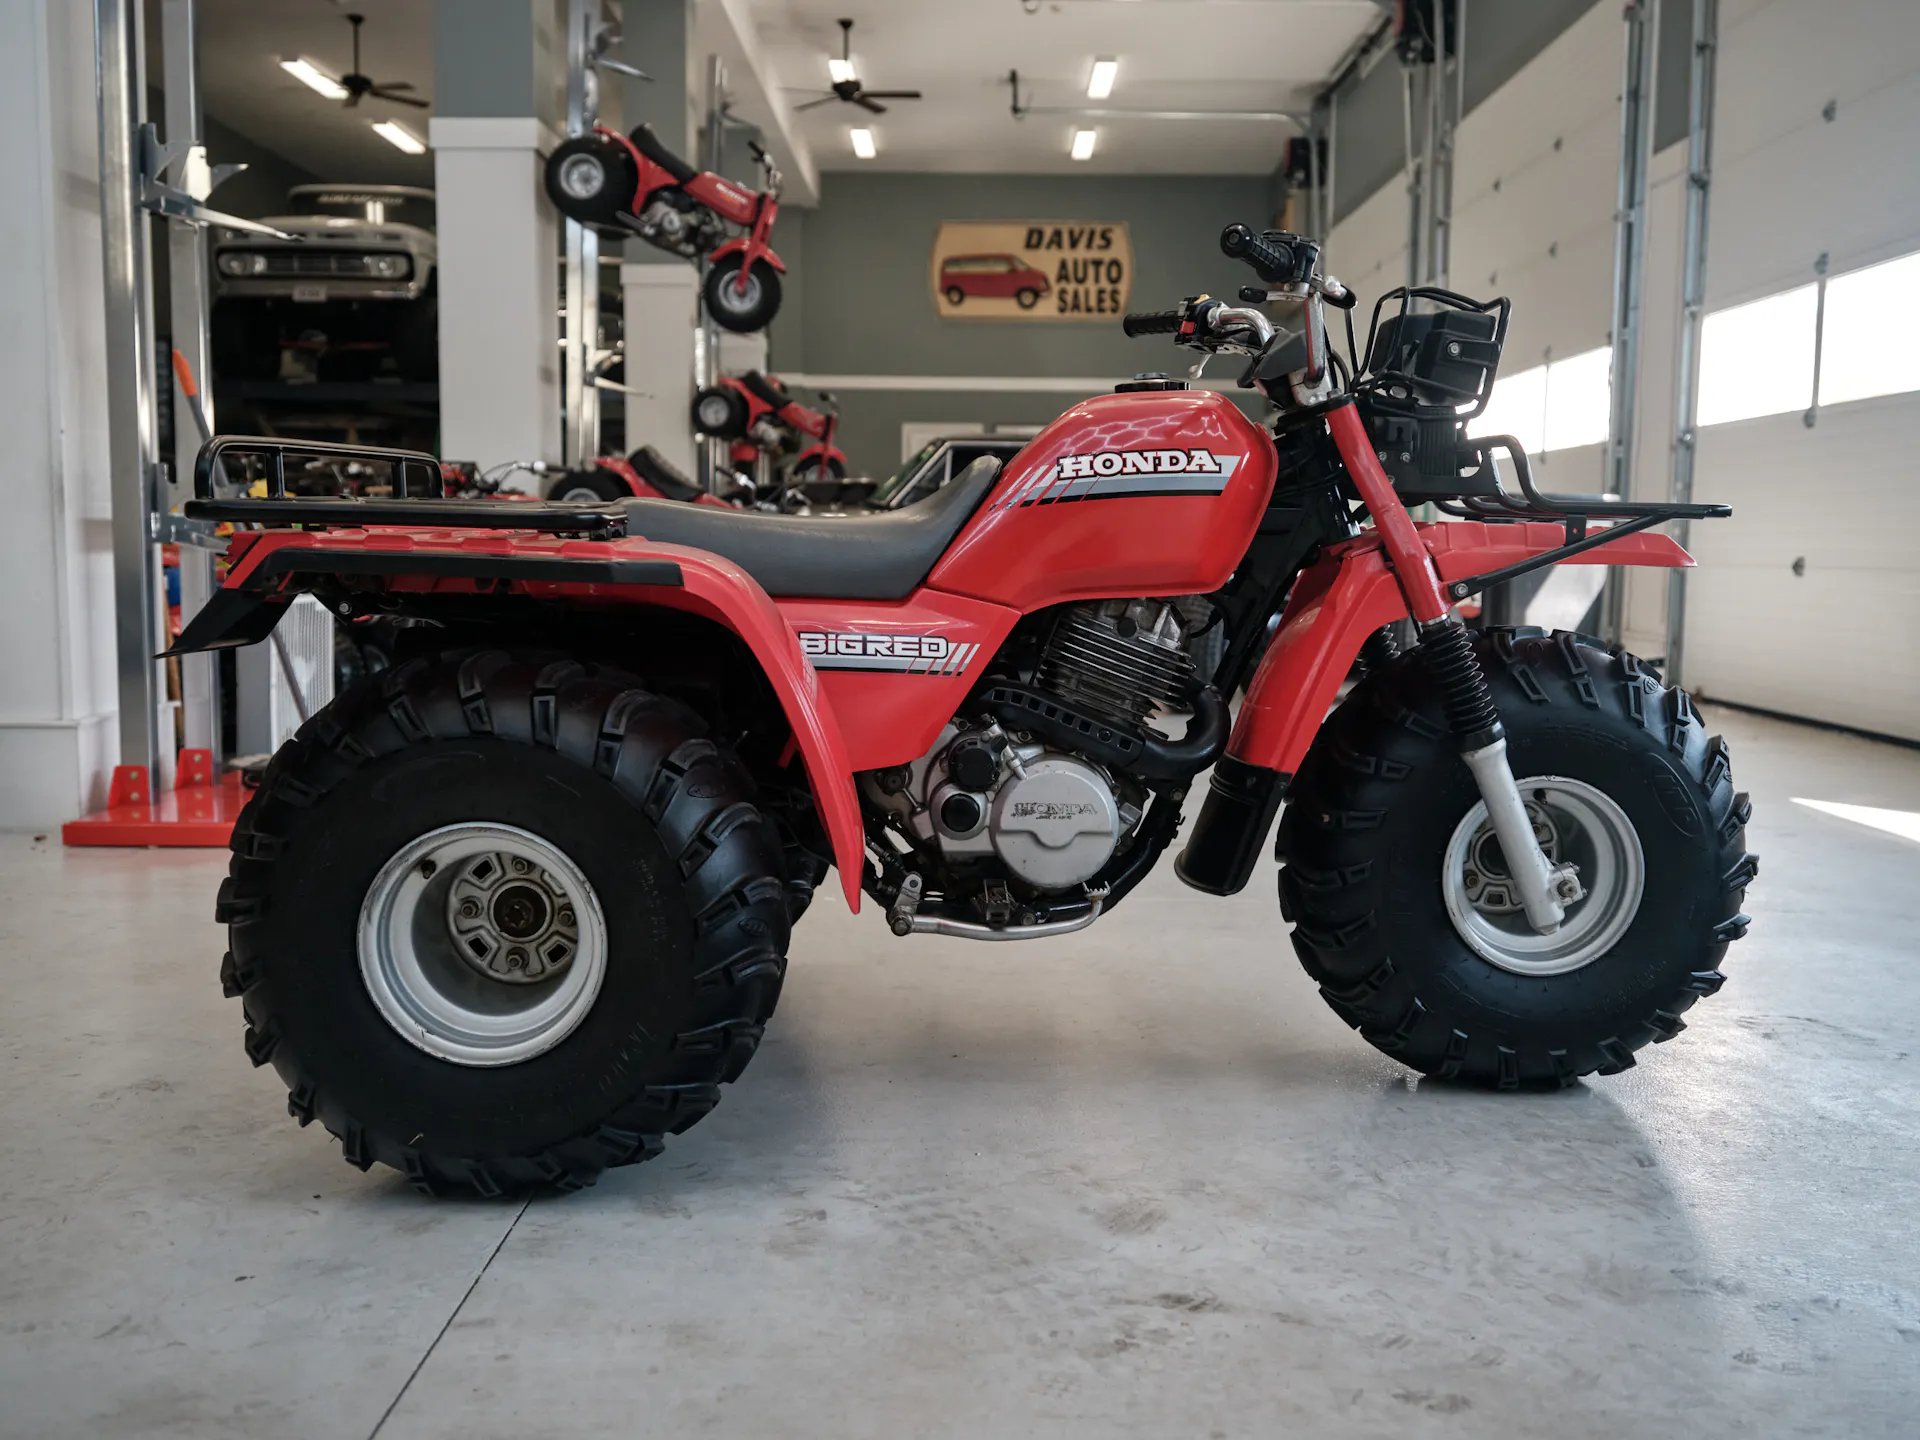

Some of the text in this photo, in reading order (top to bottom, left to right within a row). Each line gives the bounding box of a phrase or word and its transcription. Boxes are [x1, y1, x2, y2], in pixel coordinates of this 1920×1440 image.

[1025, 227, 1112, 250] DAVIS
[1056, 258, 1123, 284] AUTO
[1057, 287, 1121, 314] SALES
[1058, 449, 1221, 480] HONDA
